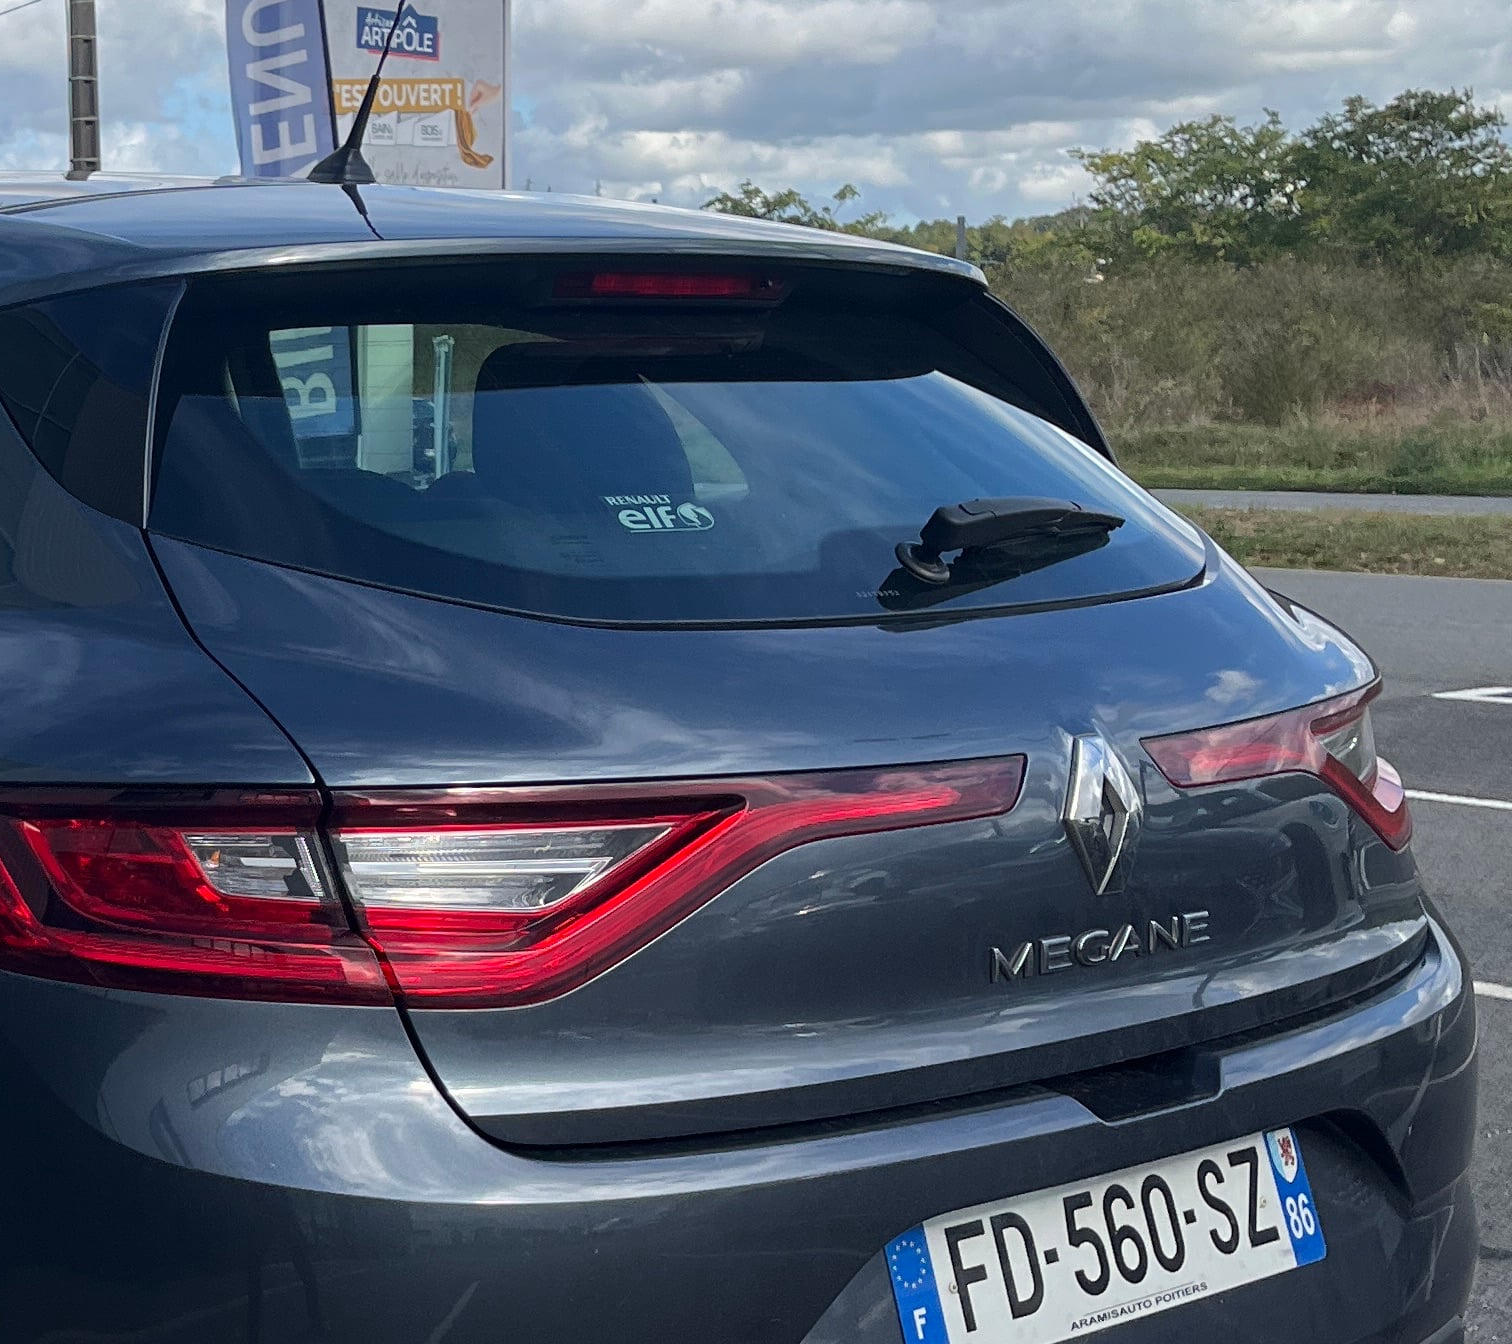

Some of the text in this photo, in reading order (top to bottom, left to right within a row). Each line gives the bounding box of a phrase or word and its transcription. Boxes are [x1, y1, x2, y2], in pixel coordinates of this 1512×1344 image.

[360, 15, 434, 53] ARTPÔLE
[379, 83, 453, 107] OUVERT
[604, 495, 671, 506] RENAULT
[618, 505, 676, 529] elf
[990, 910, 1211, 984] MEGANE
[912, 1146, 1315, 1340] F FD-560-SZ 86
[1071, 1281, 1208, 1331] ARAMISAUTO POITIERS
